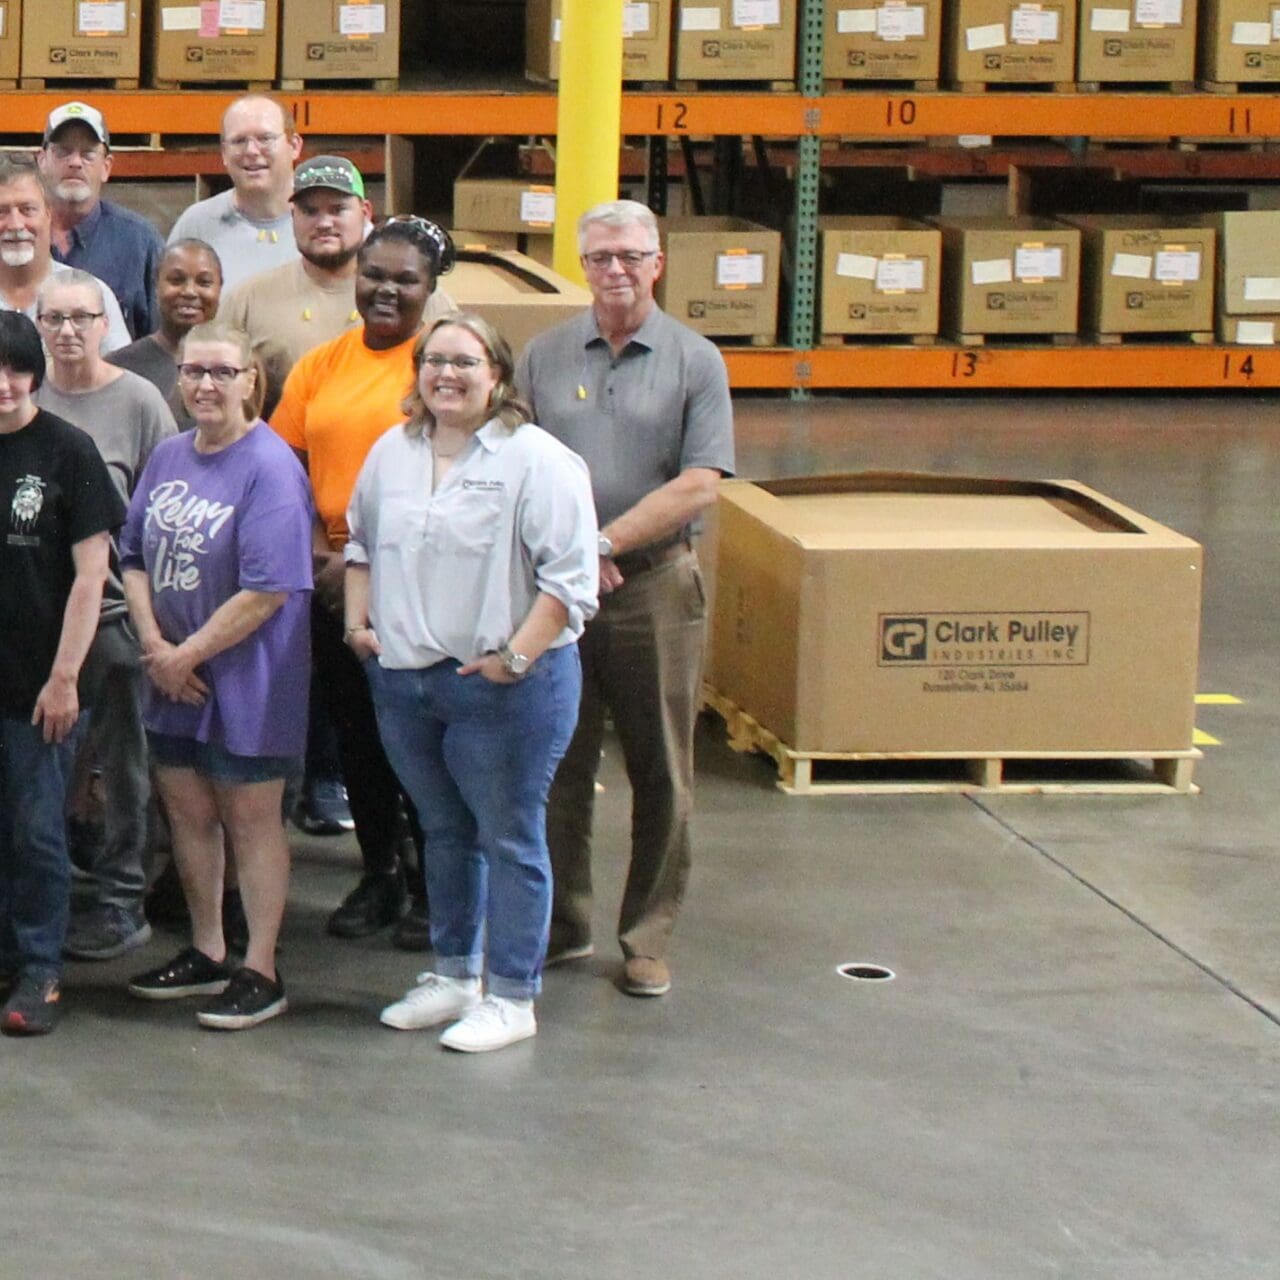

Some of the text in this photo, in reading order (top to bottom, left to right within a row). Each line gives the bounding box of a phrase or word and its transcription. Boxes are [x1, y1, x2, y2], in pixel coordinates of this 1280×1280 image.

[656, 102, 687, 130] 12
[886, 99, 916, 126] 10
[951, 352, 977, 378] 13
[1224, 354, 1254, 380] 14
[935, 620, 1079, 646] Clark Pulley
[933, 648, 1075, 661] INDUSTRIES INC
